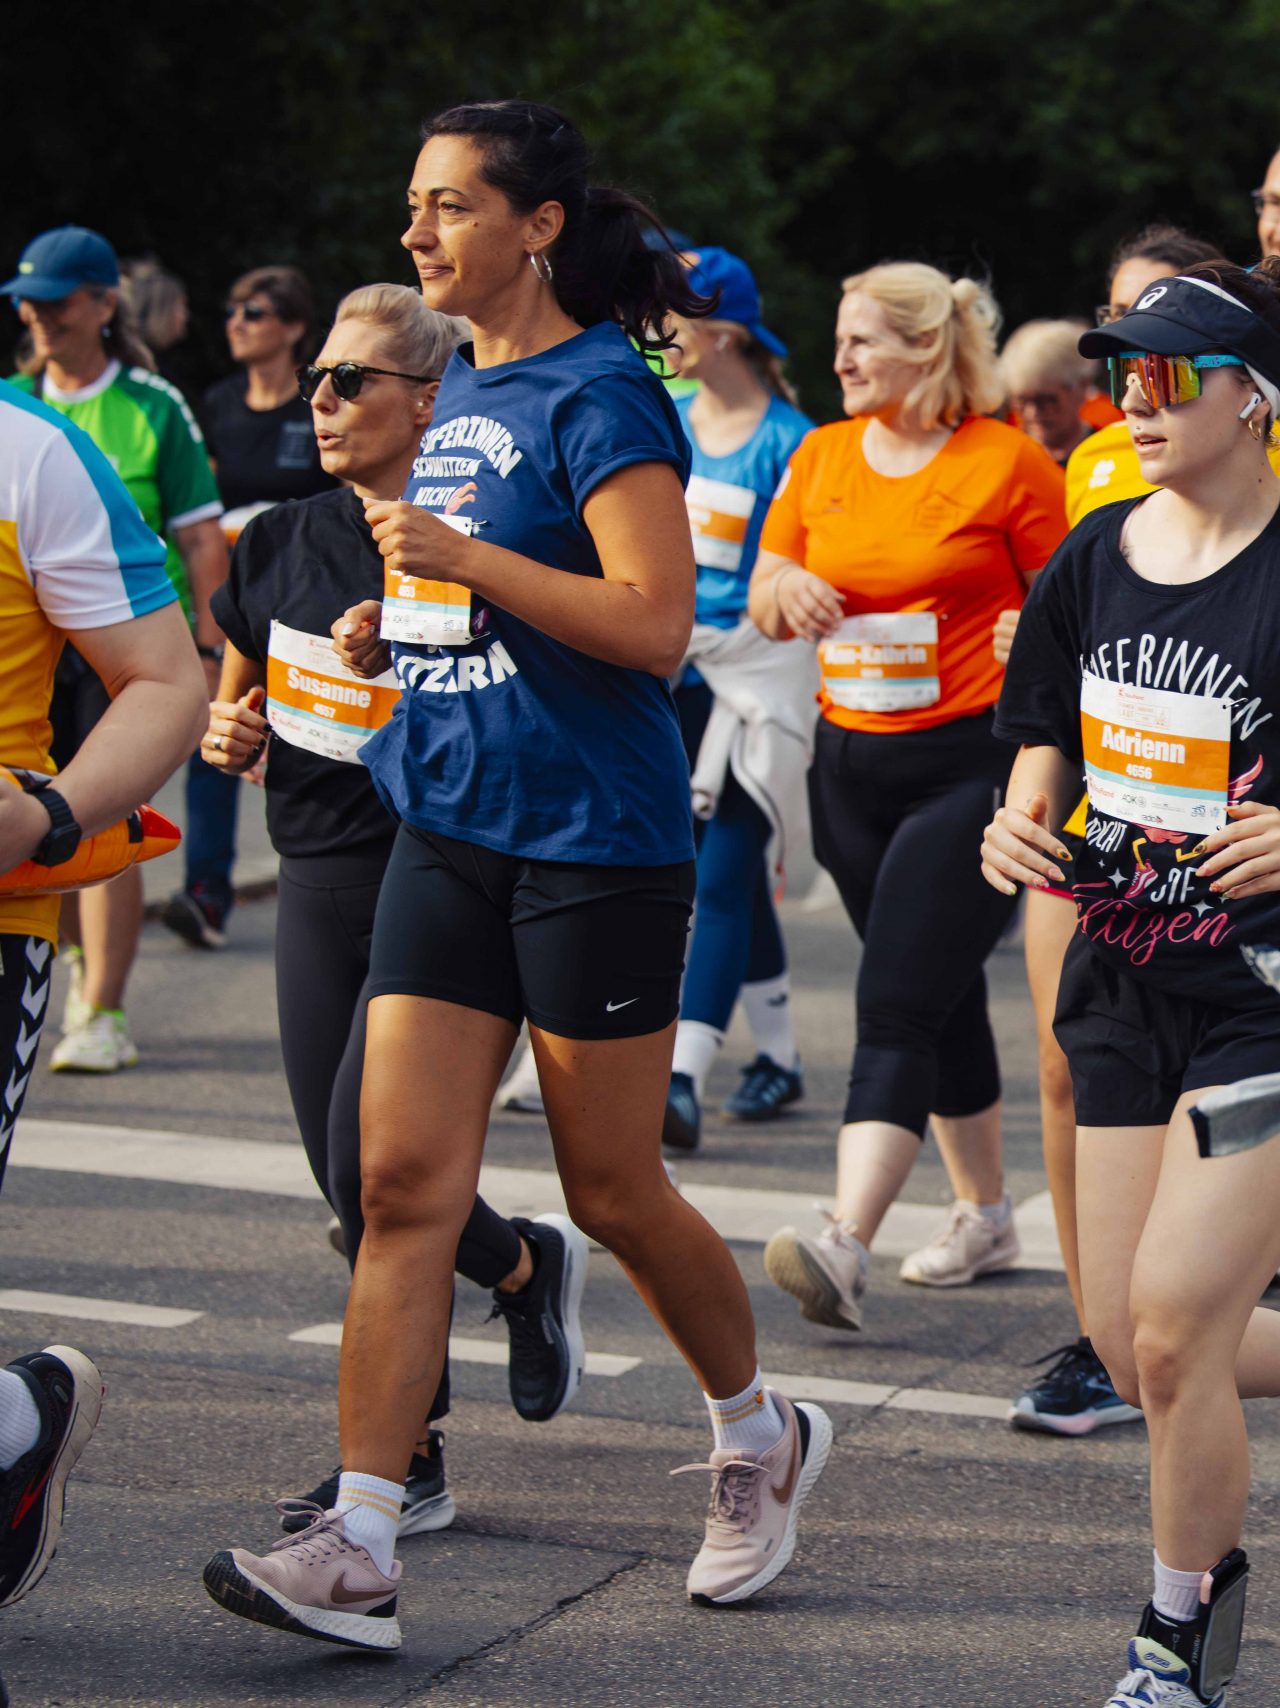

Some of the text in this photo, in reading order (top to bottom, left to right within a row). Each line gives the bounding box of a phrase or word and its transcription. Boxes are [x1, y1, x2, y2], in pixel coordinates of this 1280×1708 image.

[412, 487, 457, 506] NICHT
[287, 666, 371, 708] Susanne
[1101, 723, 1186, 765] Adrienn
